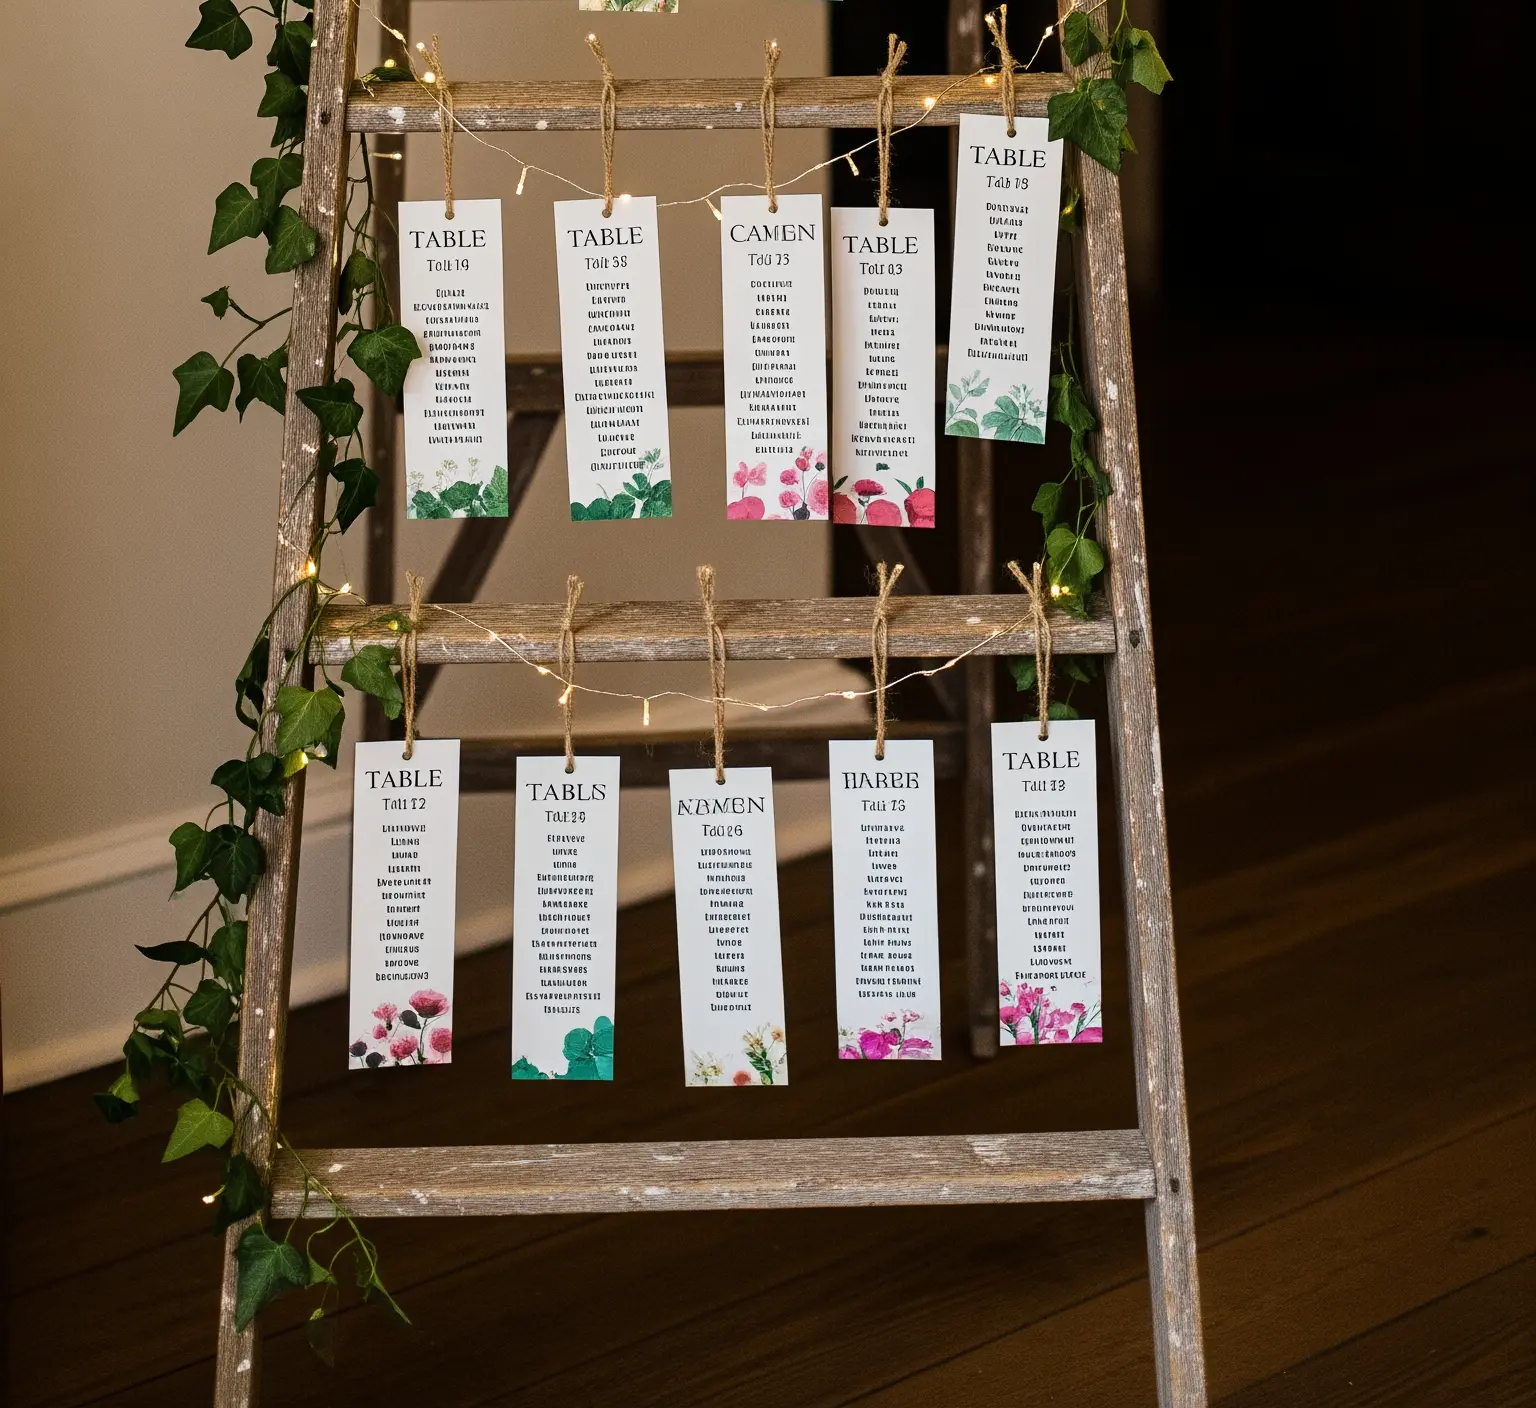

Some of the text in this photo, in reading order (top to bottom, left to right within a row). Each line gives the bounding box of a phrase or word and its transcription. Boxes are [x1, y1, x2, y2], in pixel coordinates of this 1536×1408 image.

[970, 146, 1046, 168] TABLE
[409, 230, 486, 248] TABLE
[567, 227, 643, 247] TABLE
[843, 236, 918, 254] TABLE
[1002, 751, 1080, 770] TABLE
[365, 770, 442, 789] TABLE
